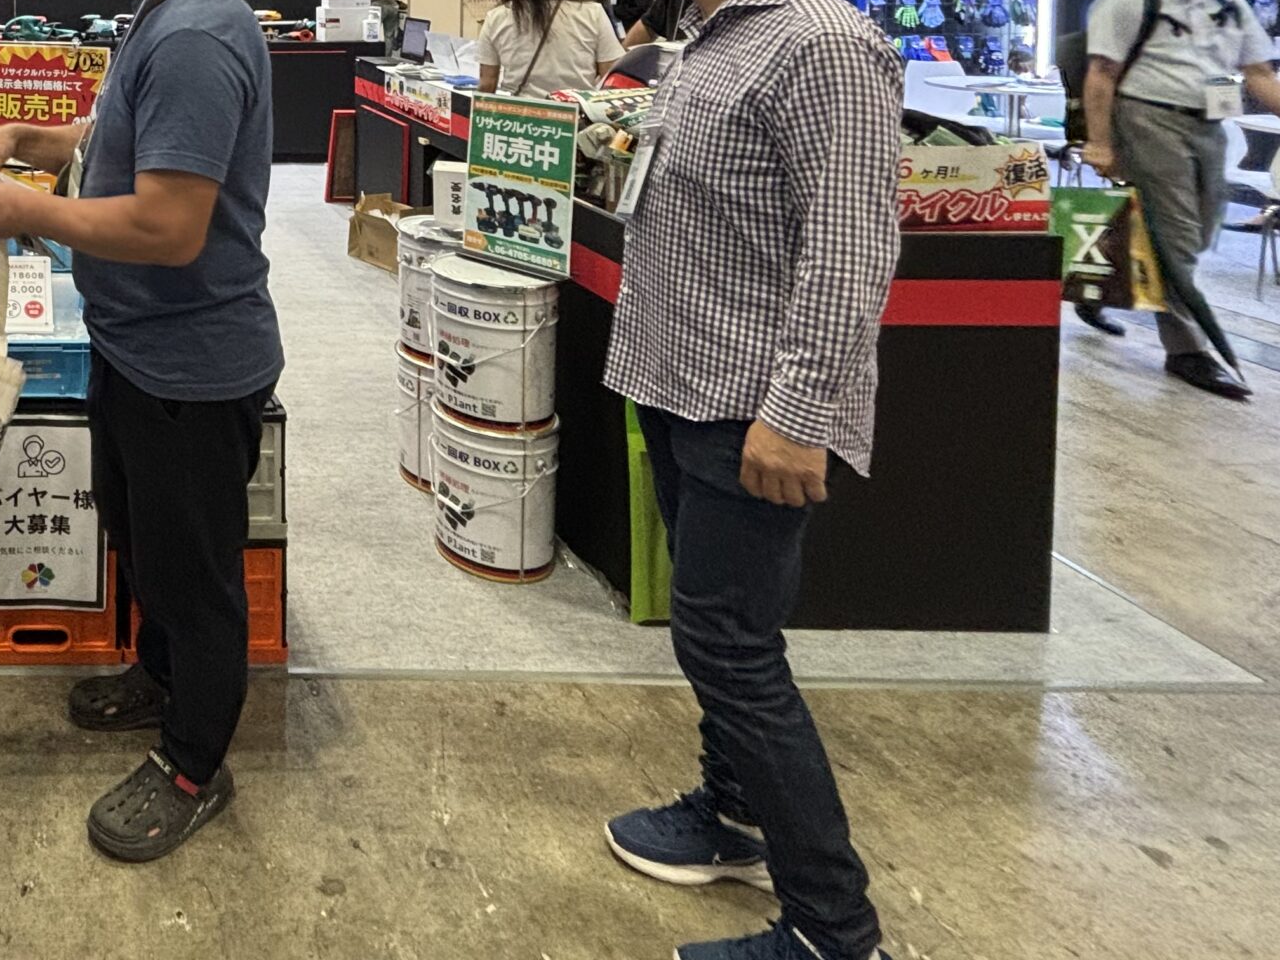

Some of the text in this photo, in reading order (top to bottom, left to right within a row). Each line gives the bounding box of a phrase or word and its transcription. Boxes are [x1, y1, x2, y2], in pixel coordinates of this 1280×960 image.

[1, 67, 76, 77] リサイクルバッテリー
[475, 116, 573, 139] リサイクルバッテリー
[482, 132, 560, 171] 販売中
[898, 158, 913, 180] 6
[1004, 158, 1048, 185] 復活
[8, 271, 44, 279] 1860B
[473, 309, 501, 324] BOX
[448, 392, 479, 413] Plant
[473, 456, 501, 472] BOX
[4, 514, 71, 535] 大募集
[447, 536, 478, 559] Plant
